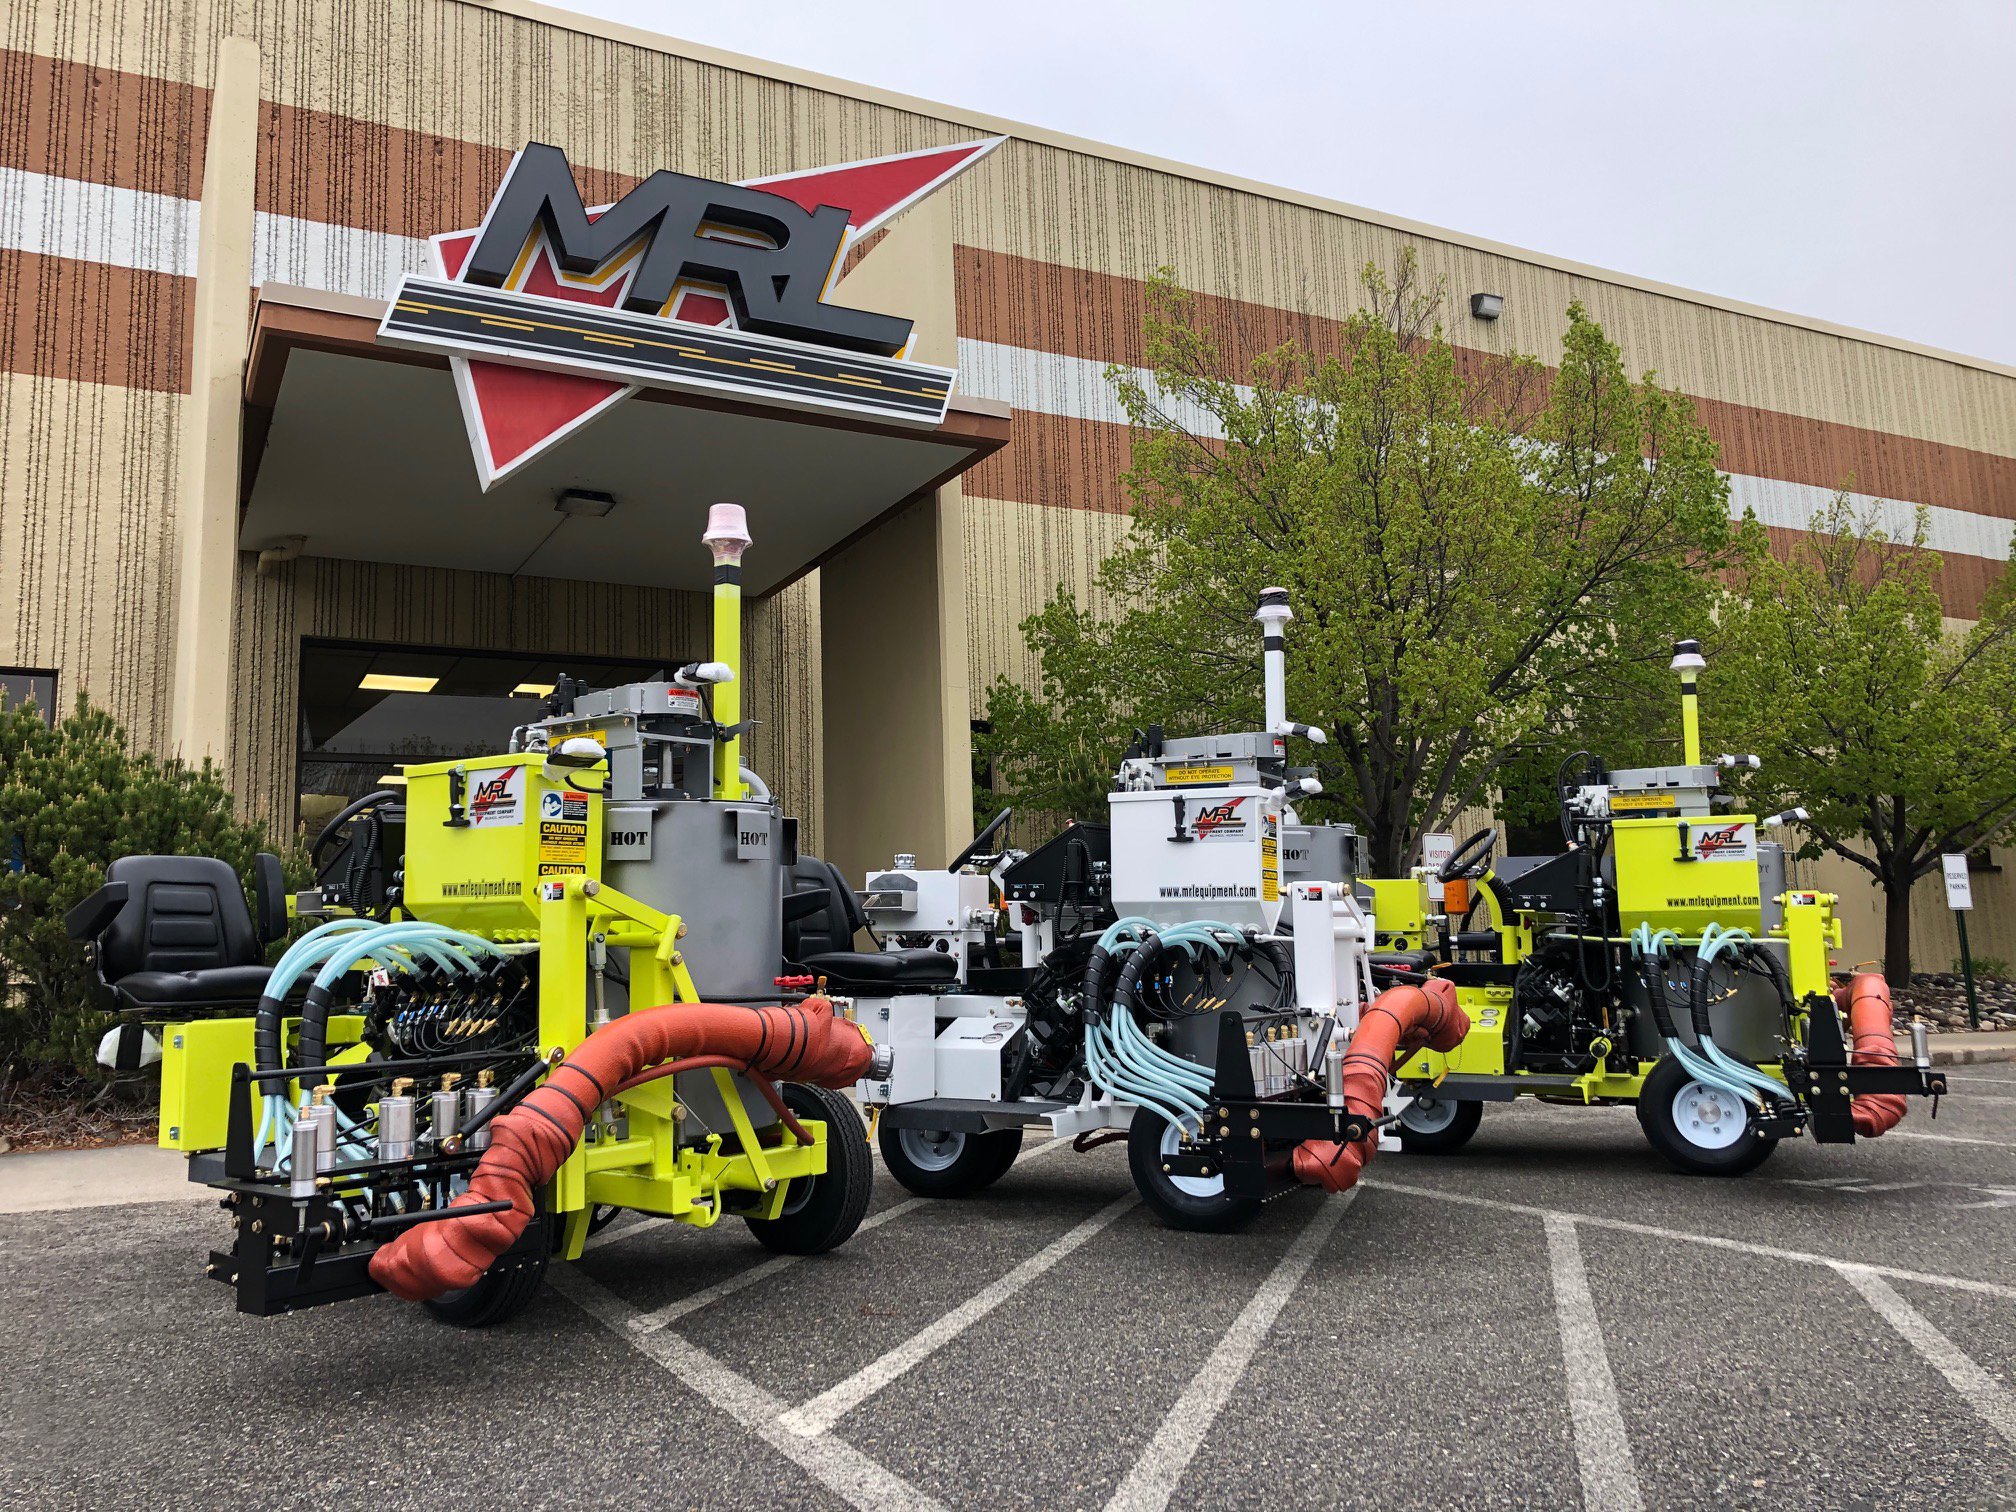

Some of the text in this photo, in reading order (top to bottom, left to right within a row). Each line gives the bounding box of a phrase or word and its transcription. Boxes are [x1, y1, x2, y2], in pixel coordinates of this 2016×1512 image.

[463, 140, 915, 358] MRL
[476, 779, 513, 801] MRL
[1197, 806, 1242, 822] MRL
[543, 823, 585, 835] CAUTION
[610, 831, 649, 846] HOT
[740, 831, 768, 846] HOT
[1700, 830, 1742, 844] MRL
[1283, 848, 1310, 860] HOT
[541, 865, 584, 876] CAUTION
[441, 878, 522, 900] www.mrlequipment.com
[1159, 884, 1257, 900] www.mrlequipment.com
[1666, 894, 1760, 908] www.mrlequipment.com
